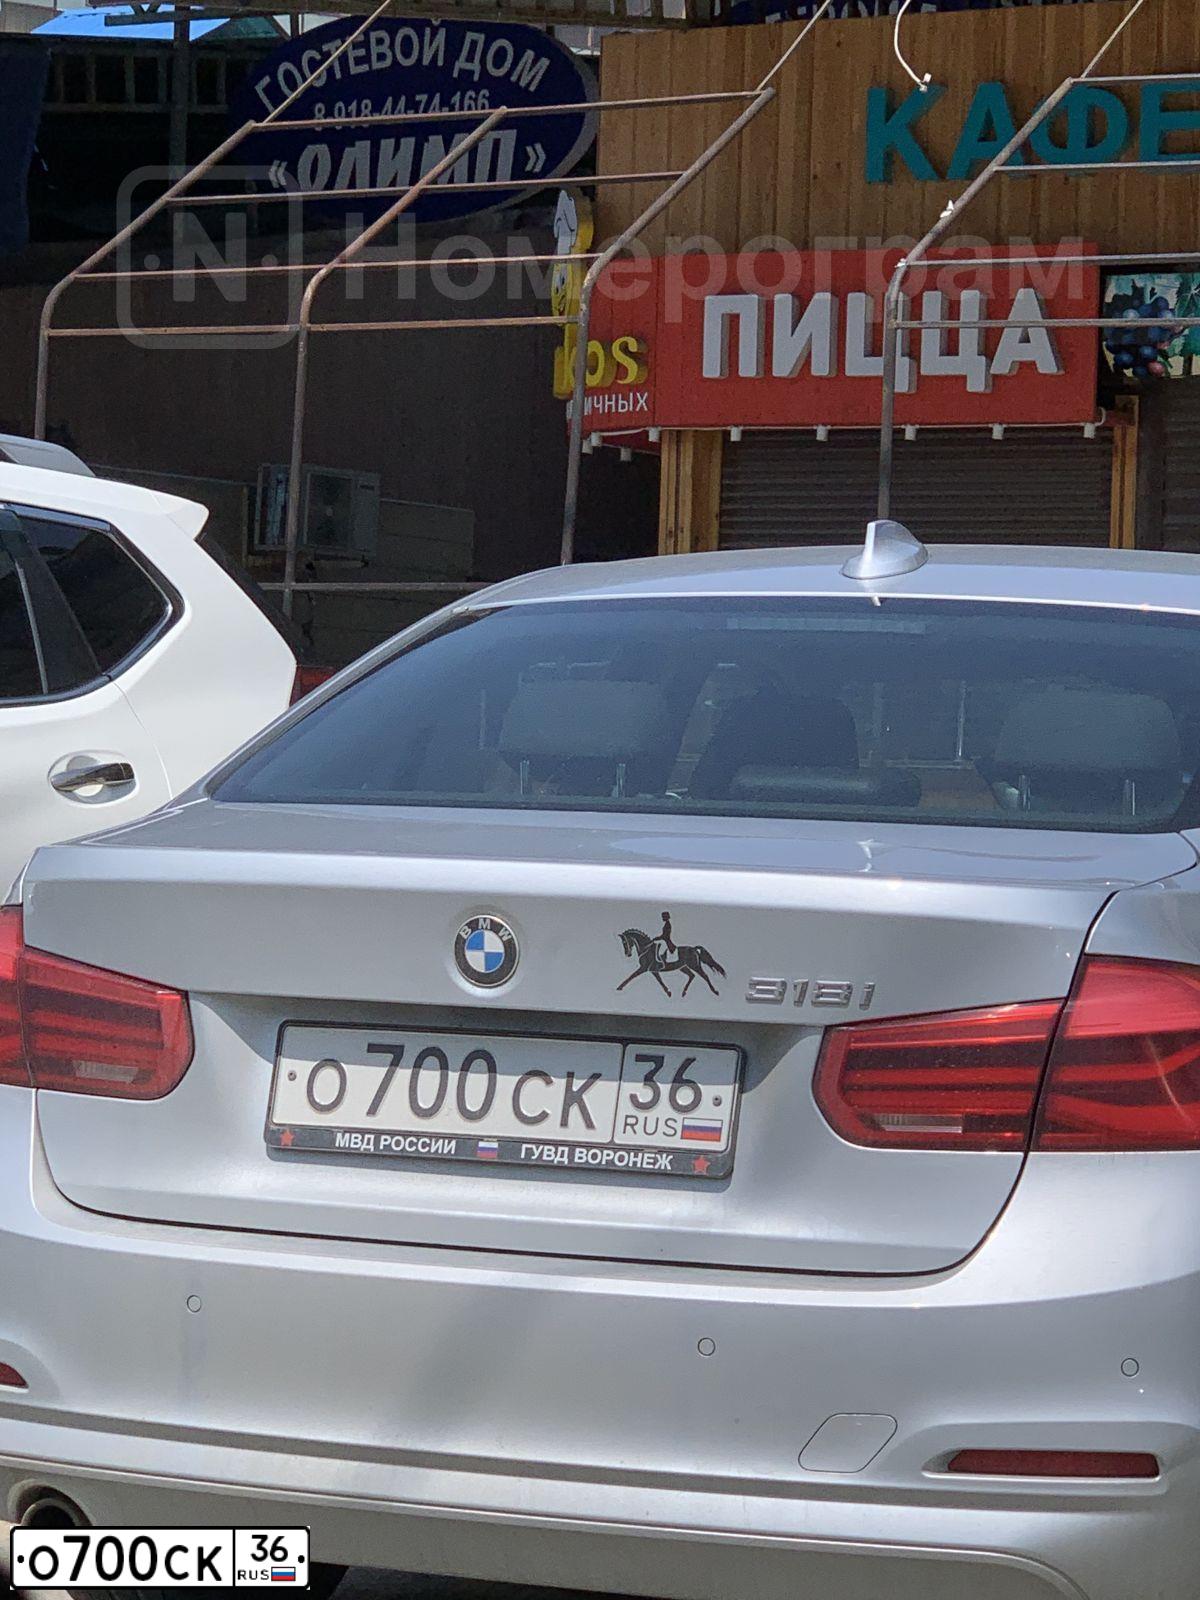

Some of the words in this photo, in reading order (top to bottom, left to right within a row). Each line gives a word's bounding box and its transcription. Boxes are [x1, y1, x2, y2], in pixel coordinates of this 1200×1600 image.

[254, 19, 446, 116] ГОСТЕВОЙ
[453, 31, 550, 92] ДОМ
[864, 80, 1200, 184] КАФЕ
[702, 287, 1063, 393] ПИЦЦА
[584, 392, 648, 416] ИЧНЫХ
[459, 918, 512, 942] BMW
[745, 976, 876, 1011] 318i
[629, 1053, 702, 1113] 36
[622, 1114, 678, 1137] RUS
[335, 1131, 375, 1151] МВД
[379, 1134, 457, 1155] РОССИИ
[520, 1143, 569, 1166] ГУВД
[574, 1148, 674, 1171] ВОРОНЕЖ
